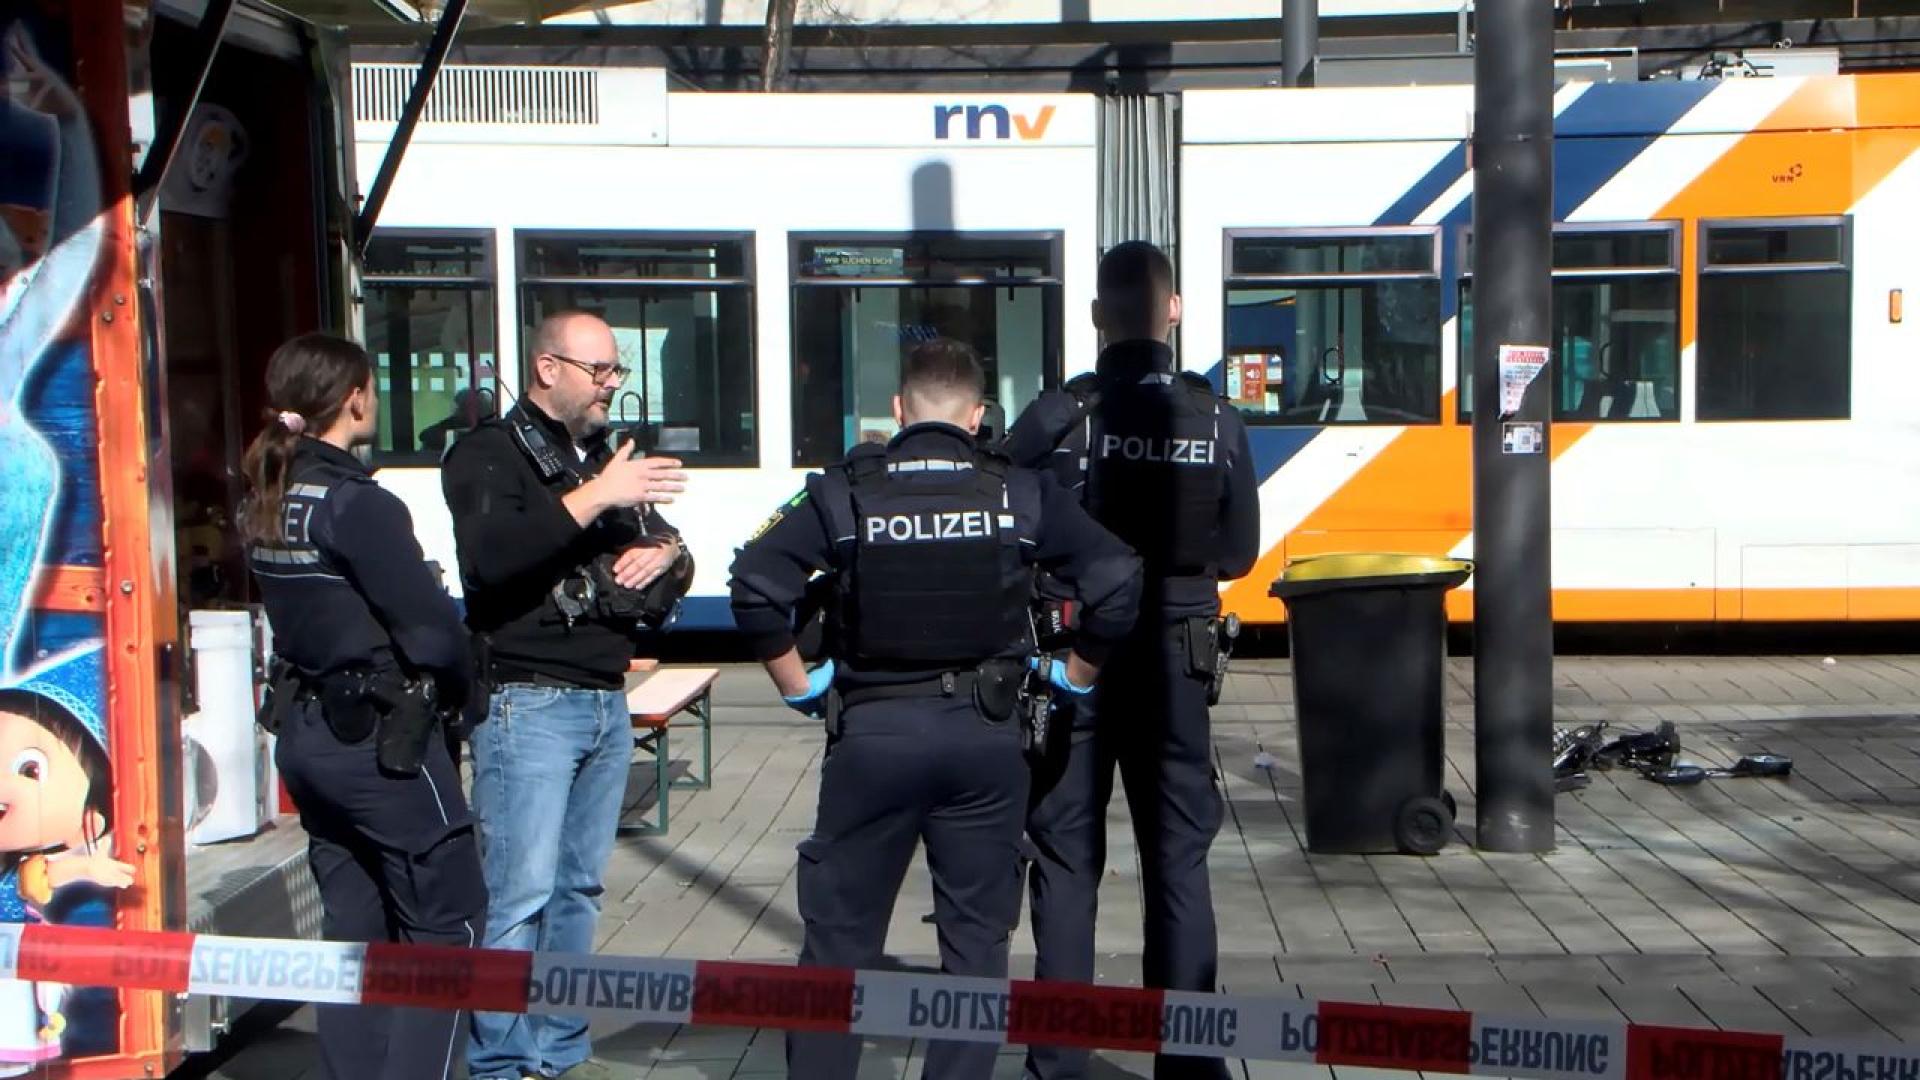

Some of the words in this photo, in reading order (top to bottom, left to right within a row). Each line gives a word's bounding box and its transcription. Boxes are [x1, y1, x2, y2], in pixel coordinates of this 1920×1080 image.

[934, 104, 1056, 140] rnv
[1102, 435, 1215, 463] POLIZEI
[282, 503, 313, 543] EI
[867, 511, 991, 542] POLIZEI
